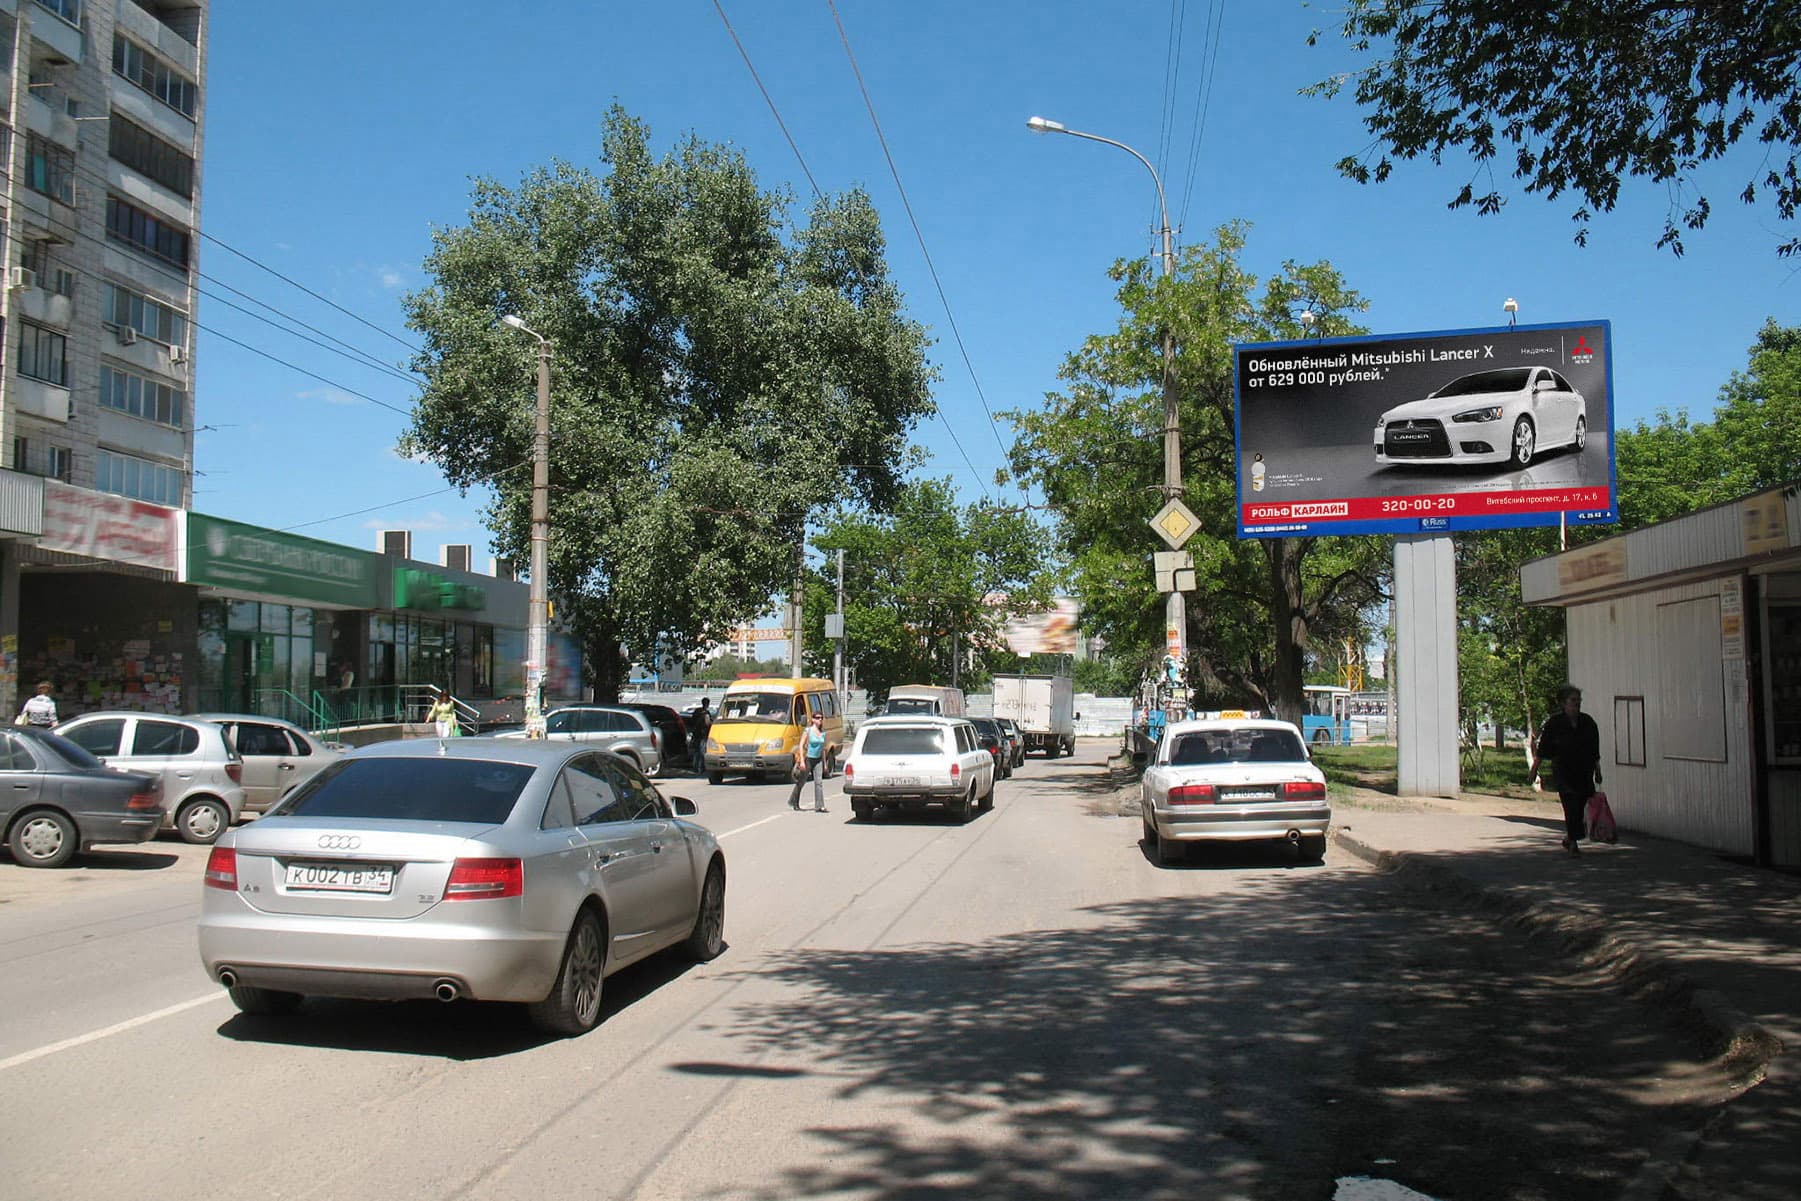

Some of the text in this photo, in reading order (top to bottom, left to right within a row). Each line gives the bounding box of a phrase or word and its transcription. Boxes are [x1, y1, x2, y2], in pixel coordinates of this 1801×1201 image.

[1248, 345, 1494, 373] Обновлённый Mitsubishi Lancer X
[1248, 377, 1265, 388] от
[1268, 373, 1294, 386] 629
[1298, 371, 1325, 385] 000
[1592, 492, 1598, 501] 6
[1251, 504, 1346, 518] РОЛЬФ КАРЛАЙН
[1382, 498, 1456, 512] 320-00-20
